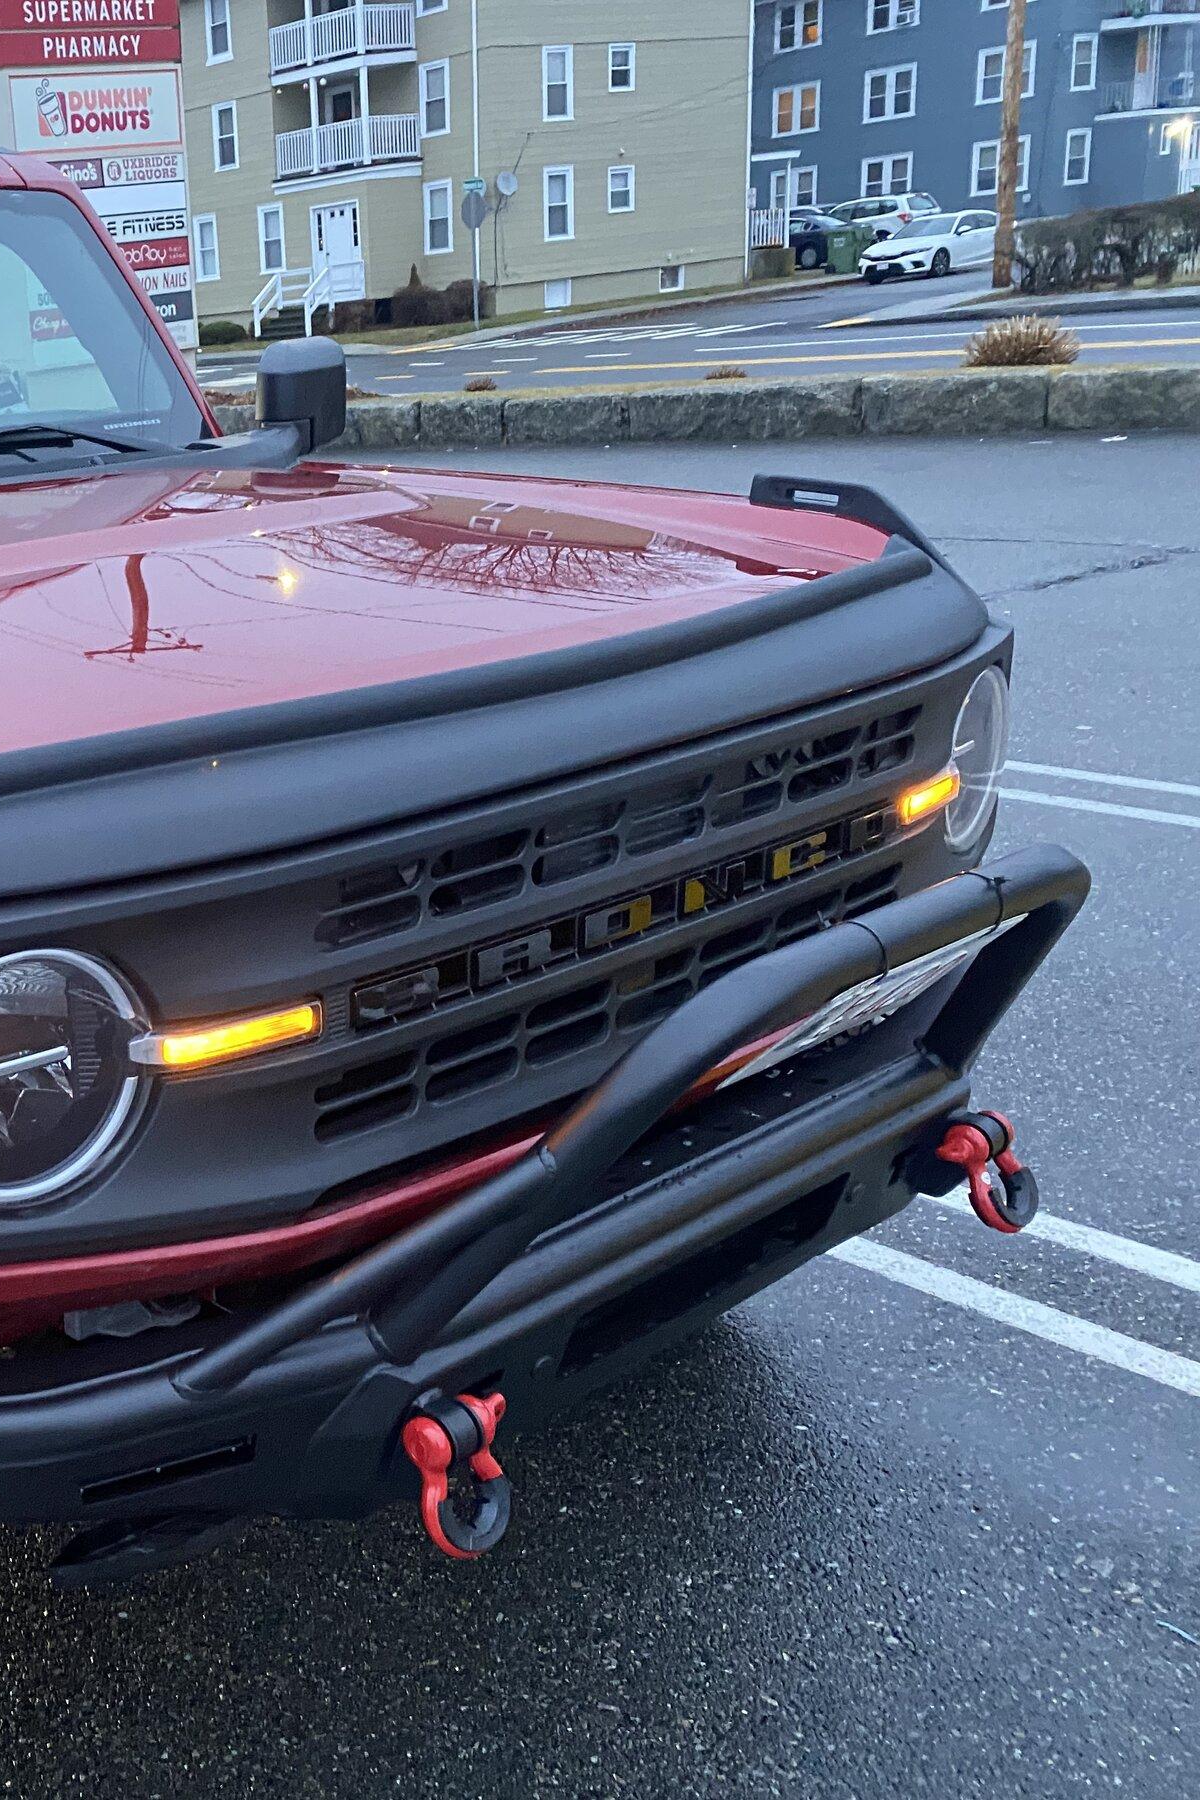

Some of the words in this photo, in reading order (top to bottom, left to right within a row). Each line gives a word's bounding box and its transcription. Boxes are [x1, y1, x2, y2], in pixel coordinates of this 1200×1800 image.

[23, 0, 154, 23] SUPERMARKET
[43, 34, 140, 58] PHARMACY
[71, 109, 150, 133] DONUTS
[122, 155, 178, 169] UXBRIDGE
[125, 167, 177, 181] LIQUORS
[122, 214, 185, 235] FITNESS
[163, 272, 187, 288] NAILS
